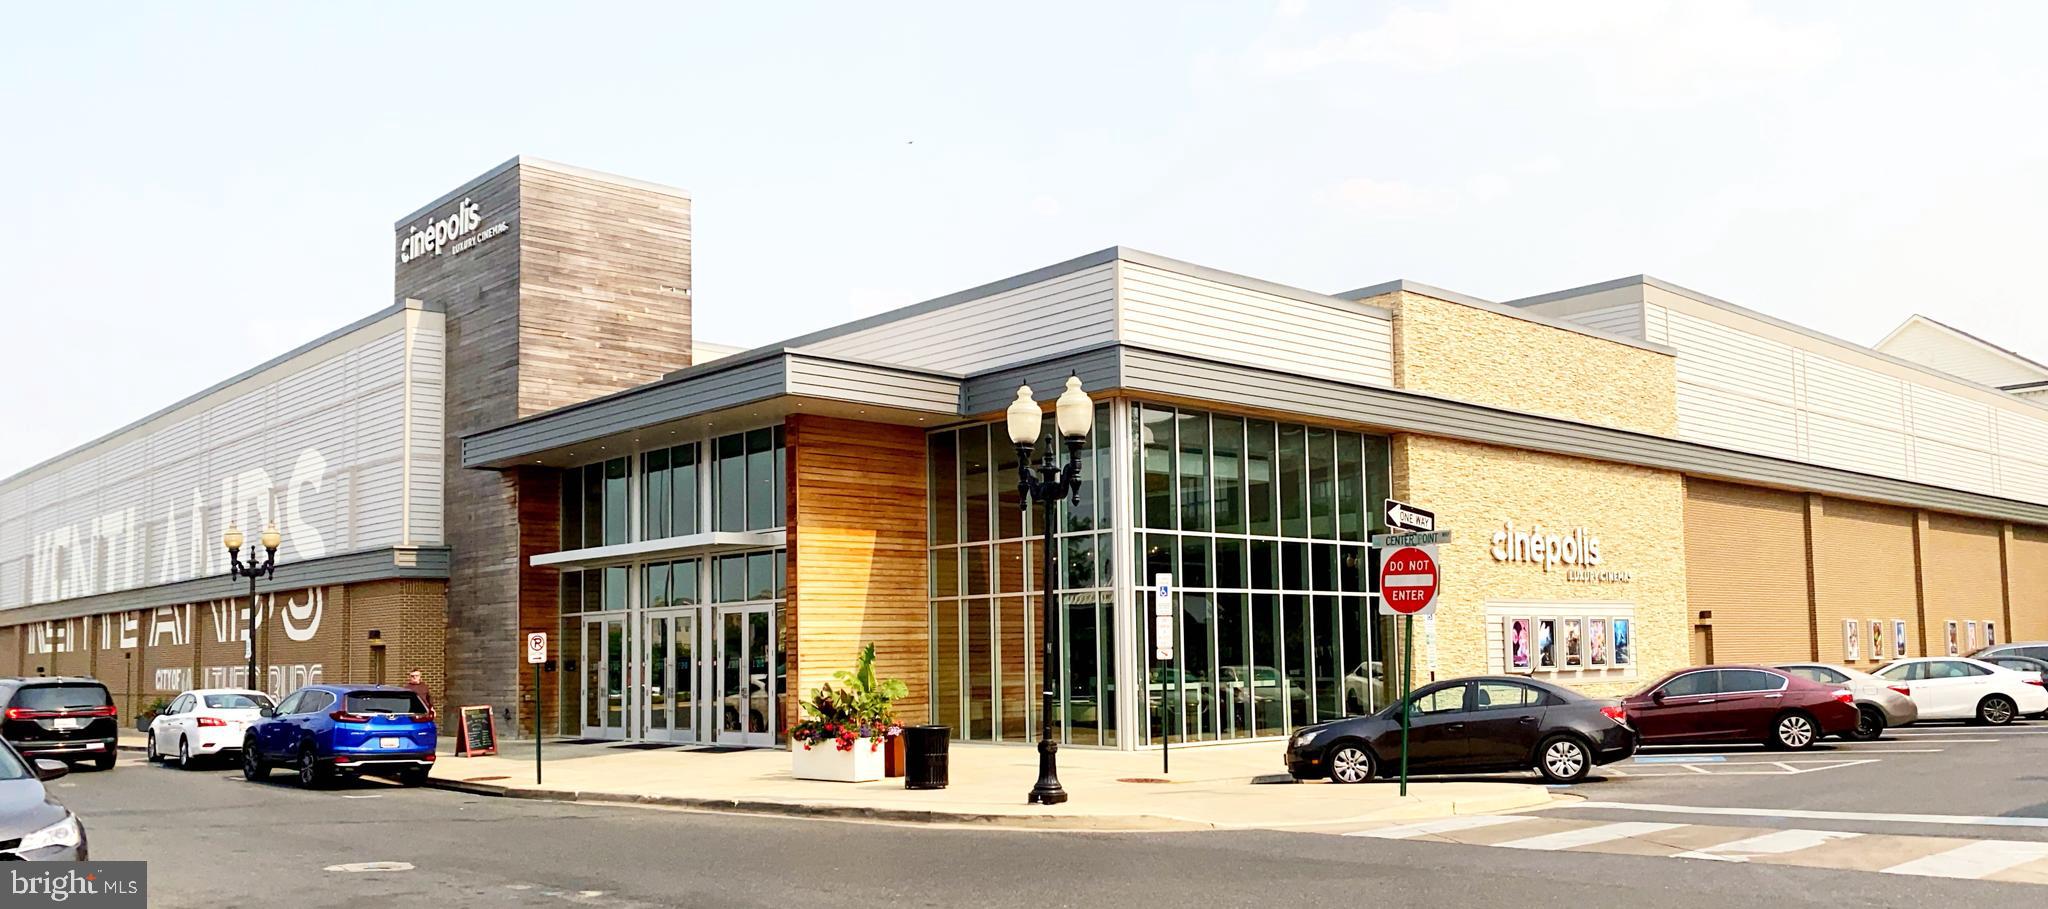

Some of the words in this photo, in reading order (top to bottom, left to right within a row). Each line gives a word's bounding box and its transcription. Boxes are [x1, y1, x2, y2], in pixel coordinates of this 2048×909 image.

[401, 197, 481, 263] cinépolis
[452, 235, 478, 255] LUXURY
[477, 221, 509, 243] CINEMAS
[1400, 511, 1414, 524] ONE
[1415, 515, 1430, 528] WAY
[1386, 534, 1414, 546] CENTER
[1417, 532, 1439, 544] POINT
[1490, 520, 1601, 573] cinépolis
[1389, 561, 1404, 571] DO
[1409, 560, 1430, 570] NOT
[1392, 590, 1425, 601] ENTER
[155, 668, 172, 691] CITY
[171, 668, 182, 690] OF
